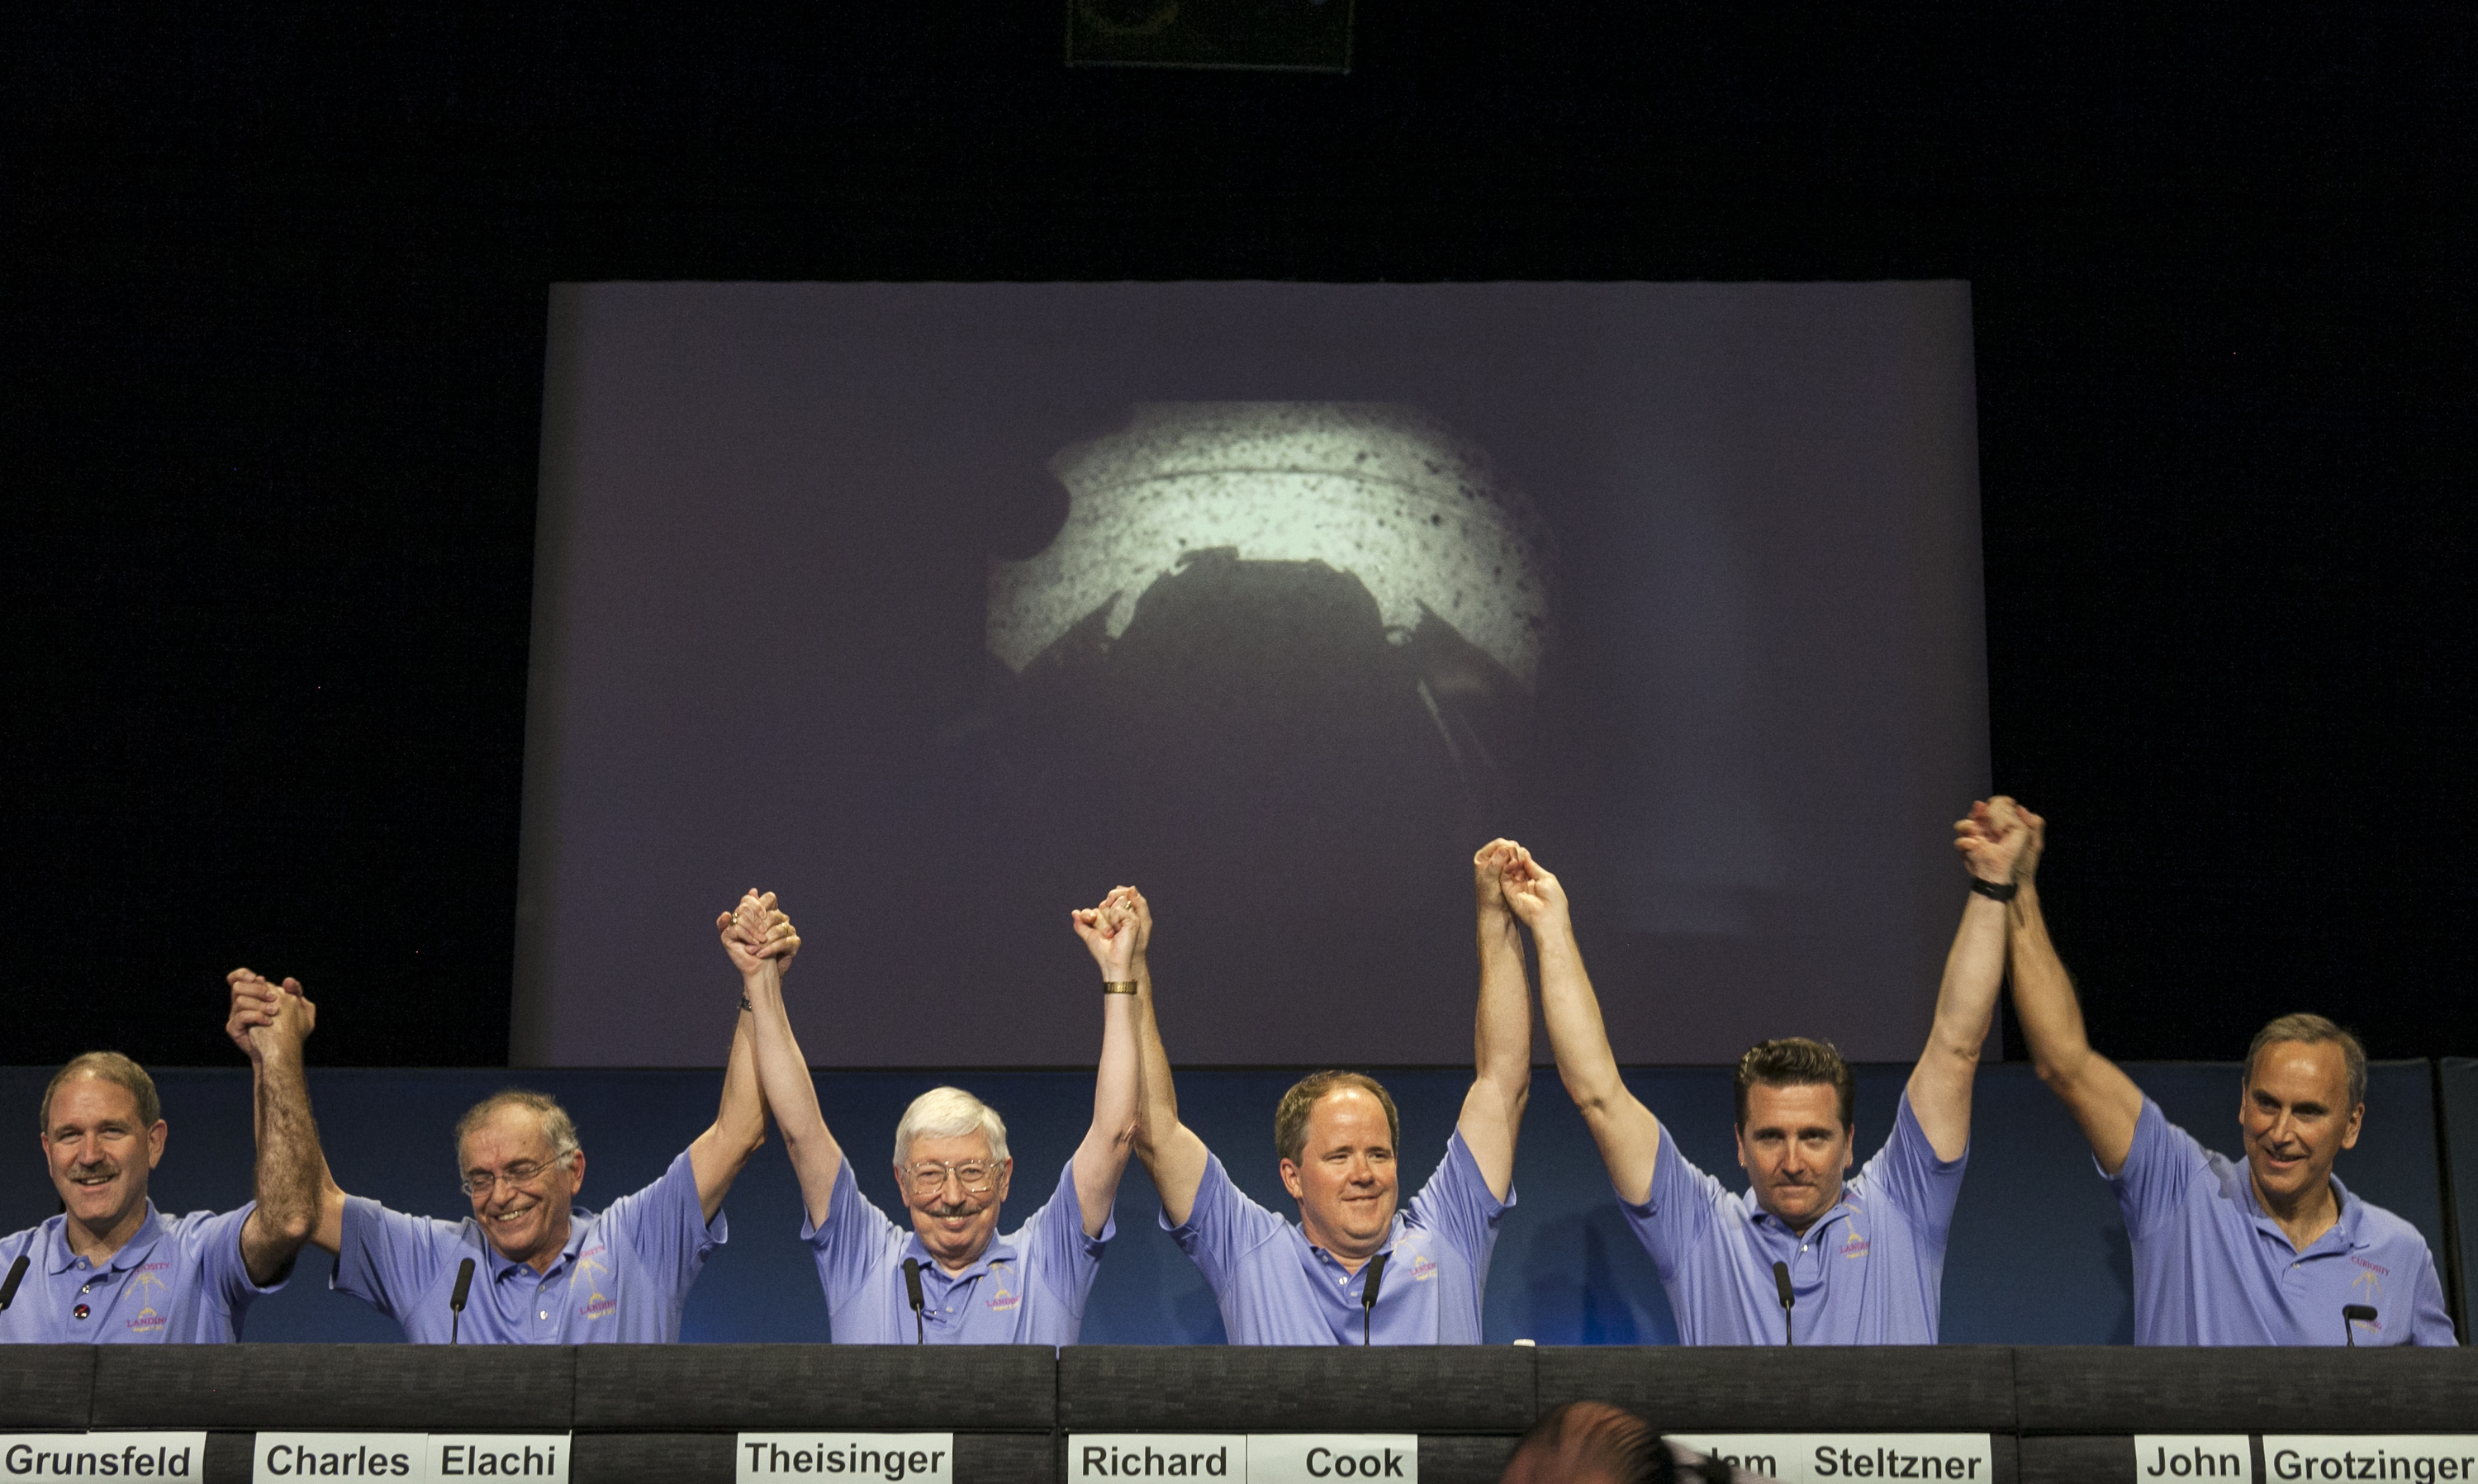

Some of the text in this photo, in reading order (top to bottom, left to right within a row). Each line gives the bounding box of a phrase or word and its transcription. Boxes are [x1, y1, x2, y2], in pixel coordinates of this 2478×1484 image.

[2351, 1255, 2390, 1277] CURIOSITY
[5, 1444, 191, 1477] Grunsfeld
[267, 1444, 555, 1477] Charles Elachi
[744, 1442, 945, 1482] Theisinger
[1082, 1446, 1404, 1478] Richard Cook
[1814, 1445, 1982, 1480] Steltzner
[2147, 1446, 2475, 1484] John Grotzinger
